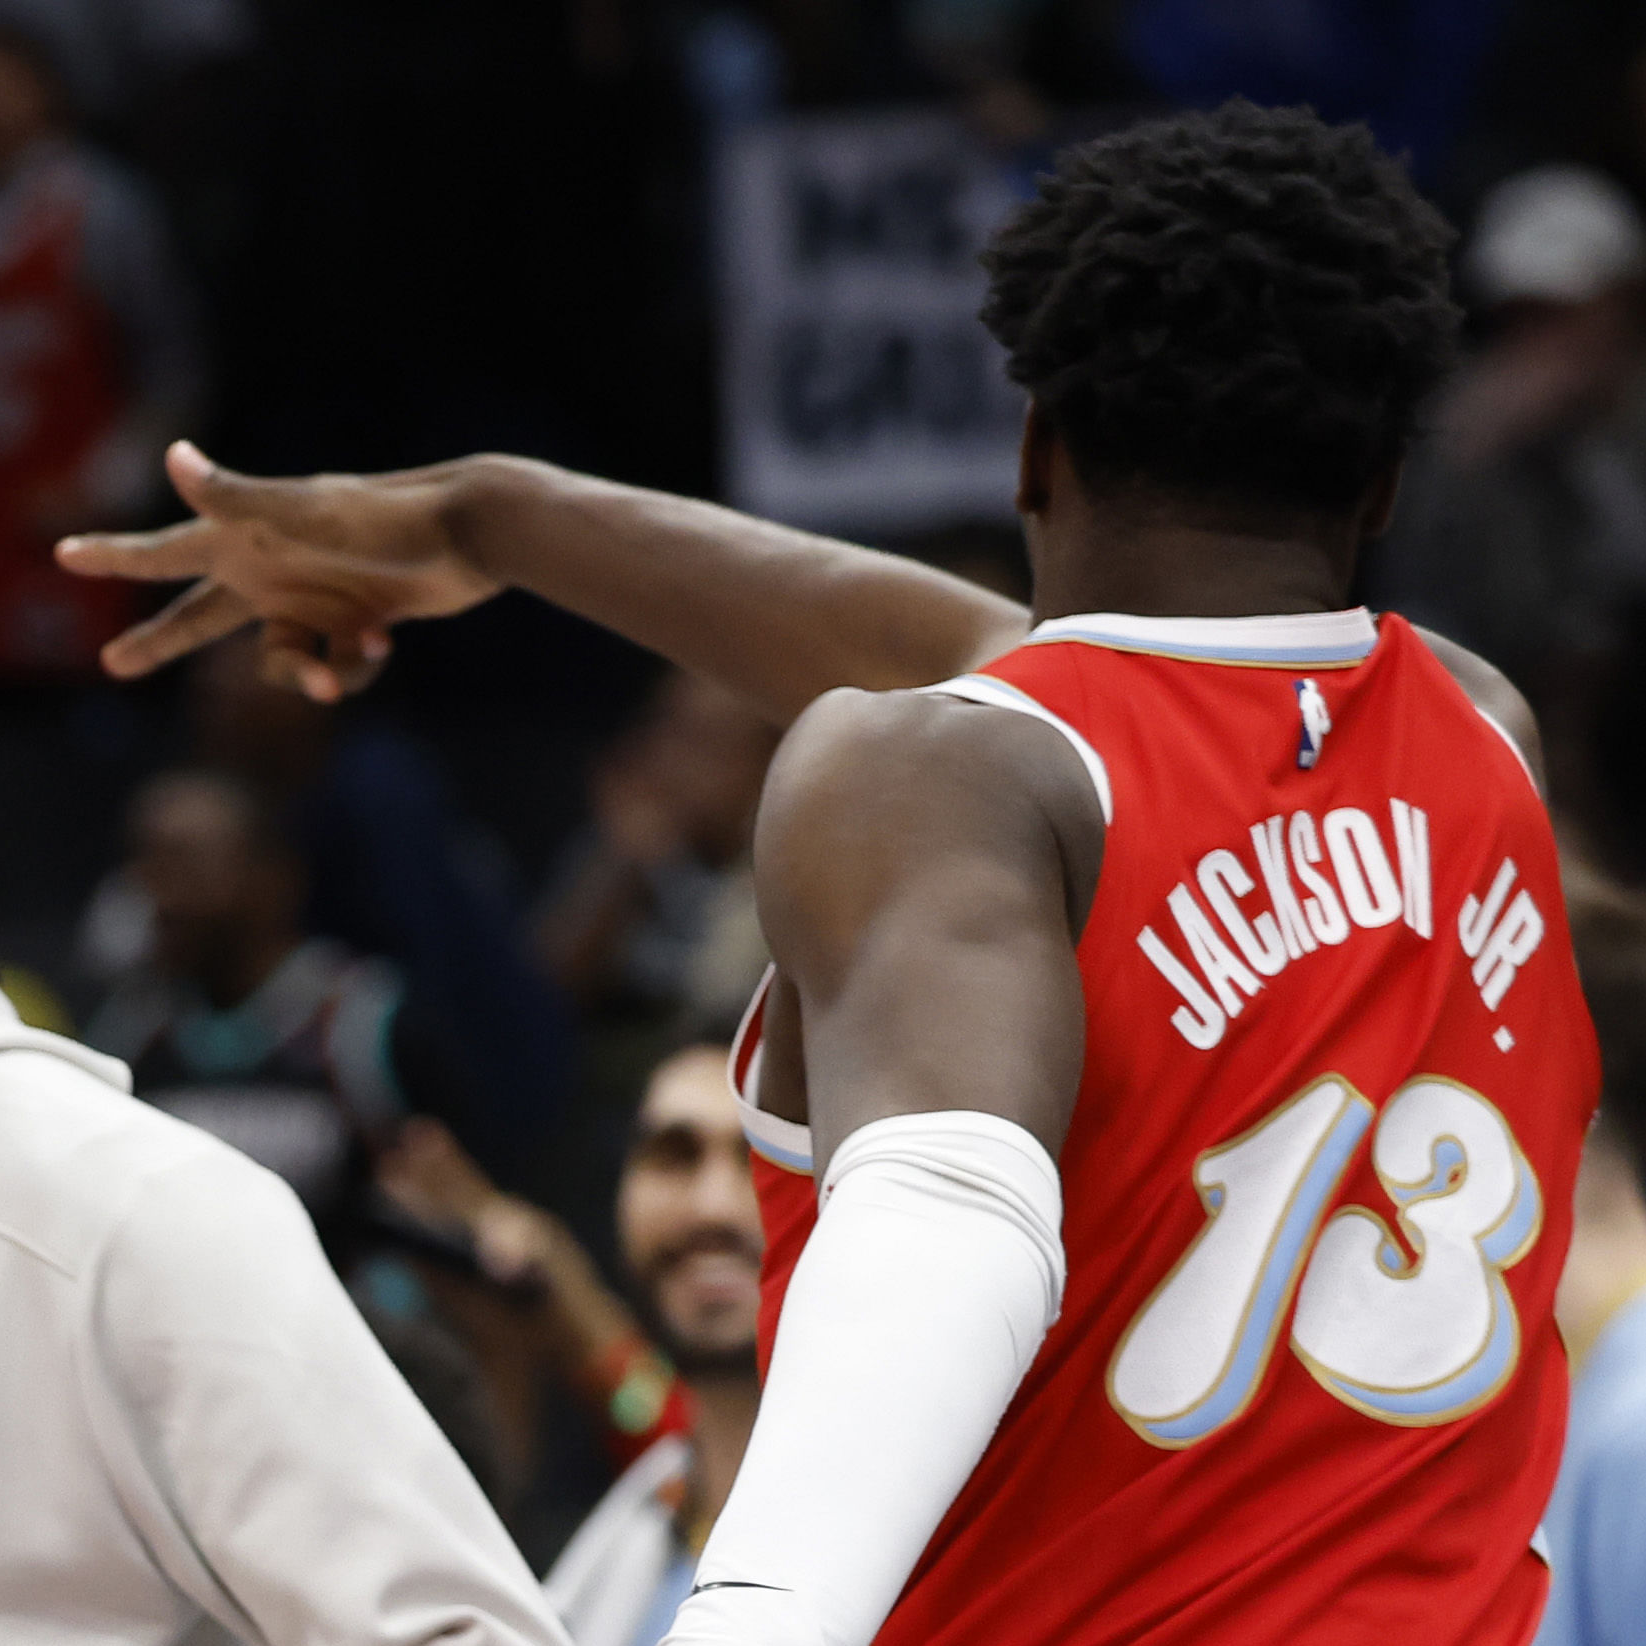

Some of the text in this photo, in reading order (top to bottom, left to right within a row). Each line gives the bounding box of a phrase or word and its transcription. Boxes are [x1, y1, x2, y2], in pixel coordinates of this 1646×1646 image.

[1135, 796, 1547, 1054] JACKSON JR.
[1104, 1072, 1545, 1451] 13
